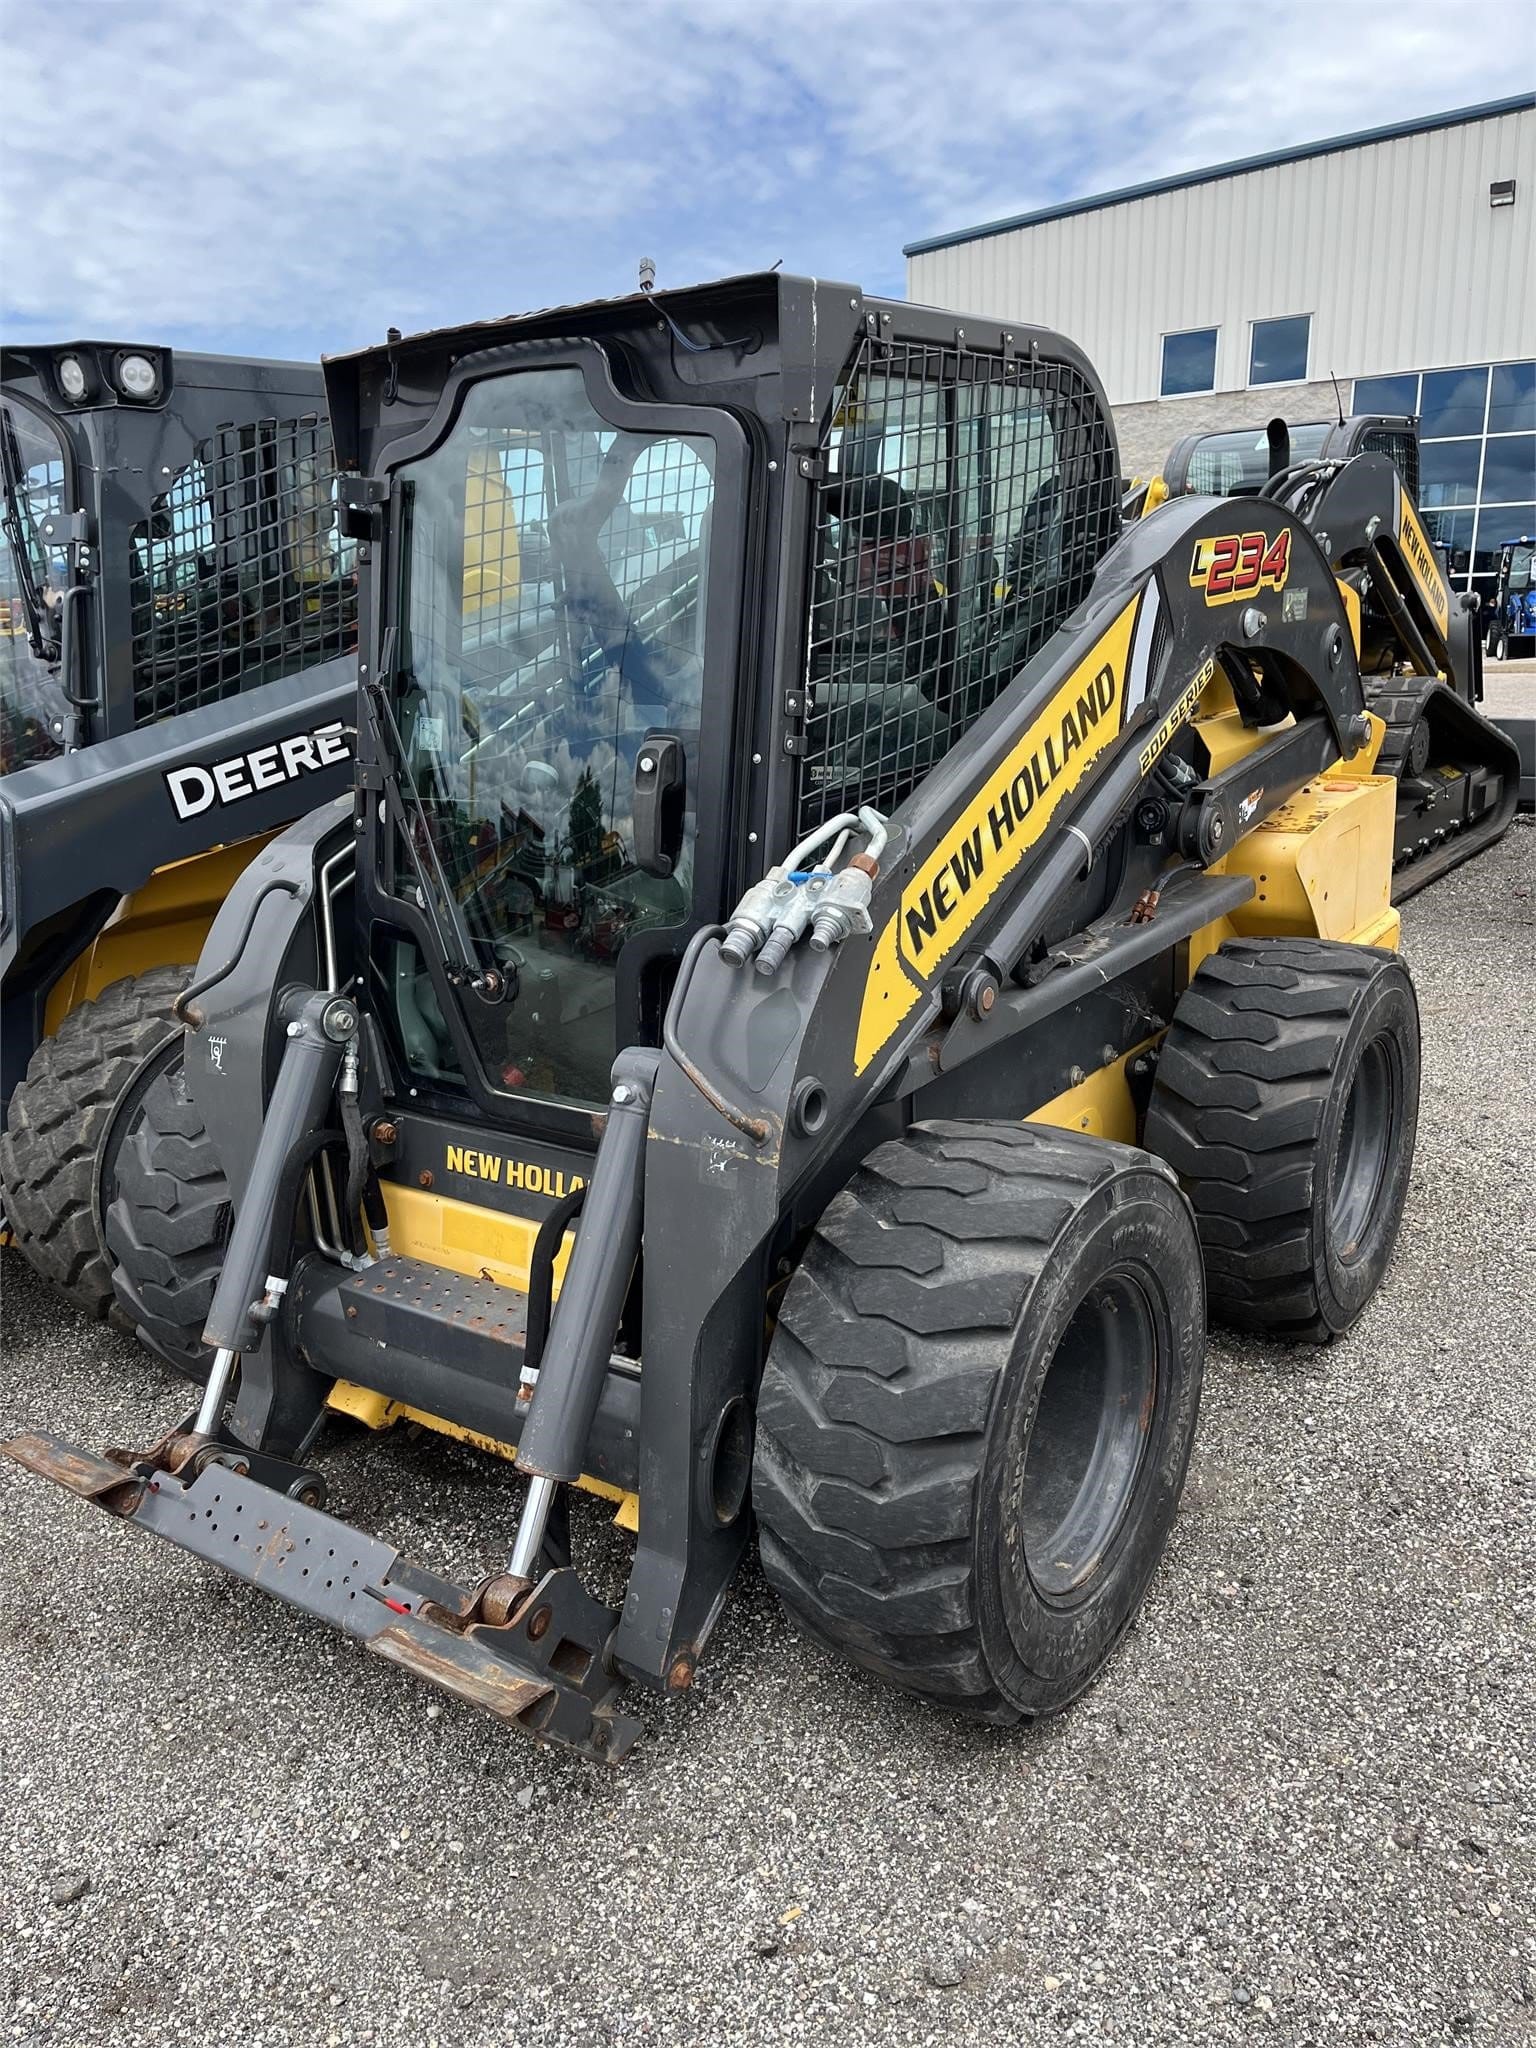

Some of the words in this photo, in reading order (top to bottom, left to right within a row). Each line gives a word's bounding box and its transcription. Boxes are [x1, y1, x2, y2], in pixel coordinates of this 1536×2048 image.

[1191, 530, 1290, 600] L234
[1402, 515, 1420, 557] NEW
[1416, 552, 1445, 614] HOLLAND
[1140, 726, 1168, 773] 200
[1170, 662, 1212, 732] SERIES
[166, 722, 350, 819] DEERE
[904, 824, 984, 956] NEW
[986, 662, 1115, 852] HOLLAND
[446, 1145, 501, 1182] NEW
[506, 1160, 590, 1199] HOLLA
